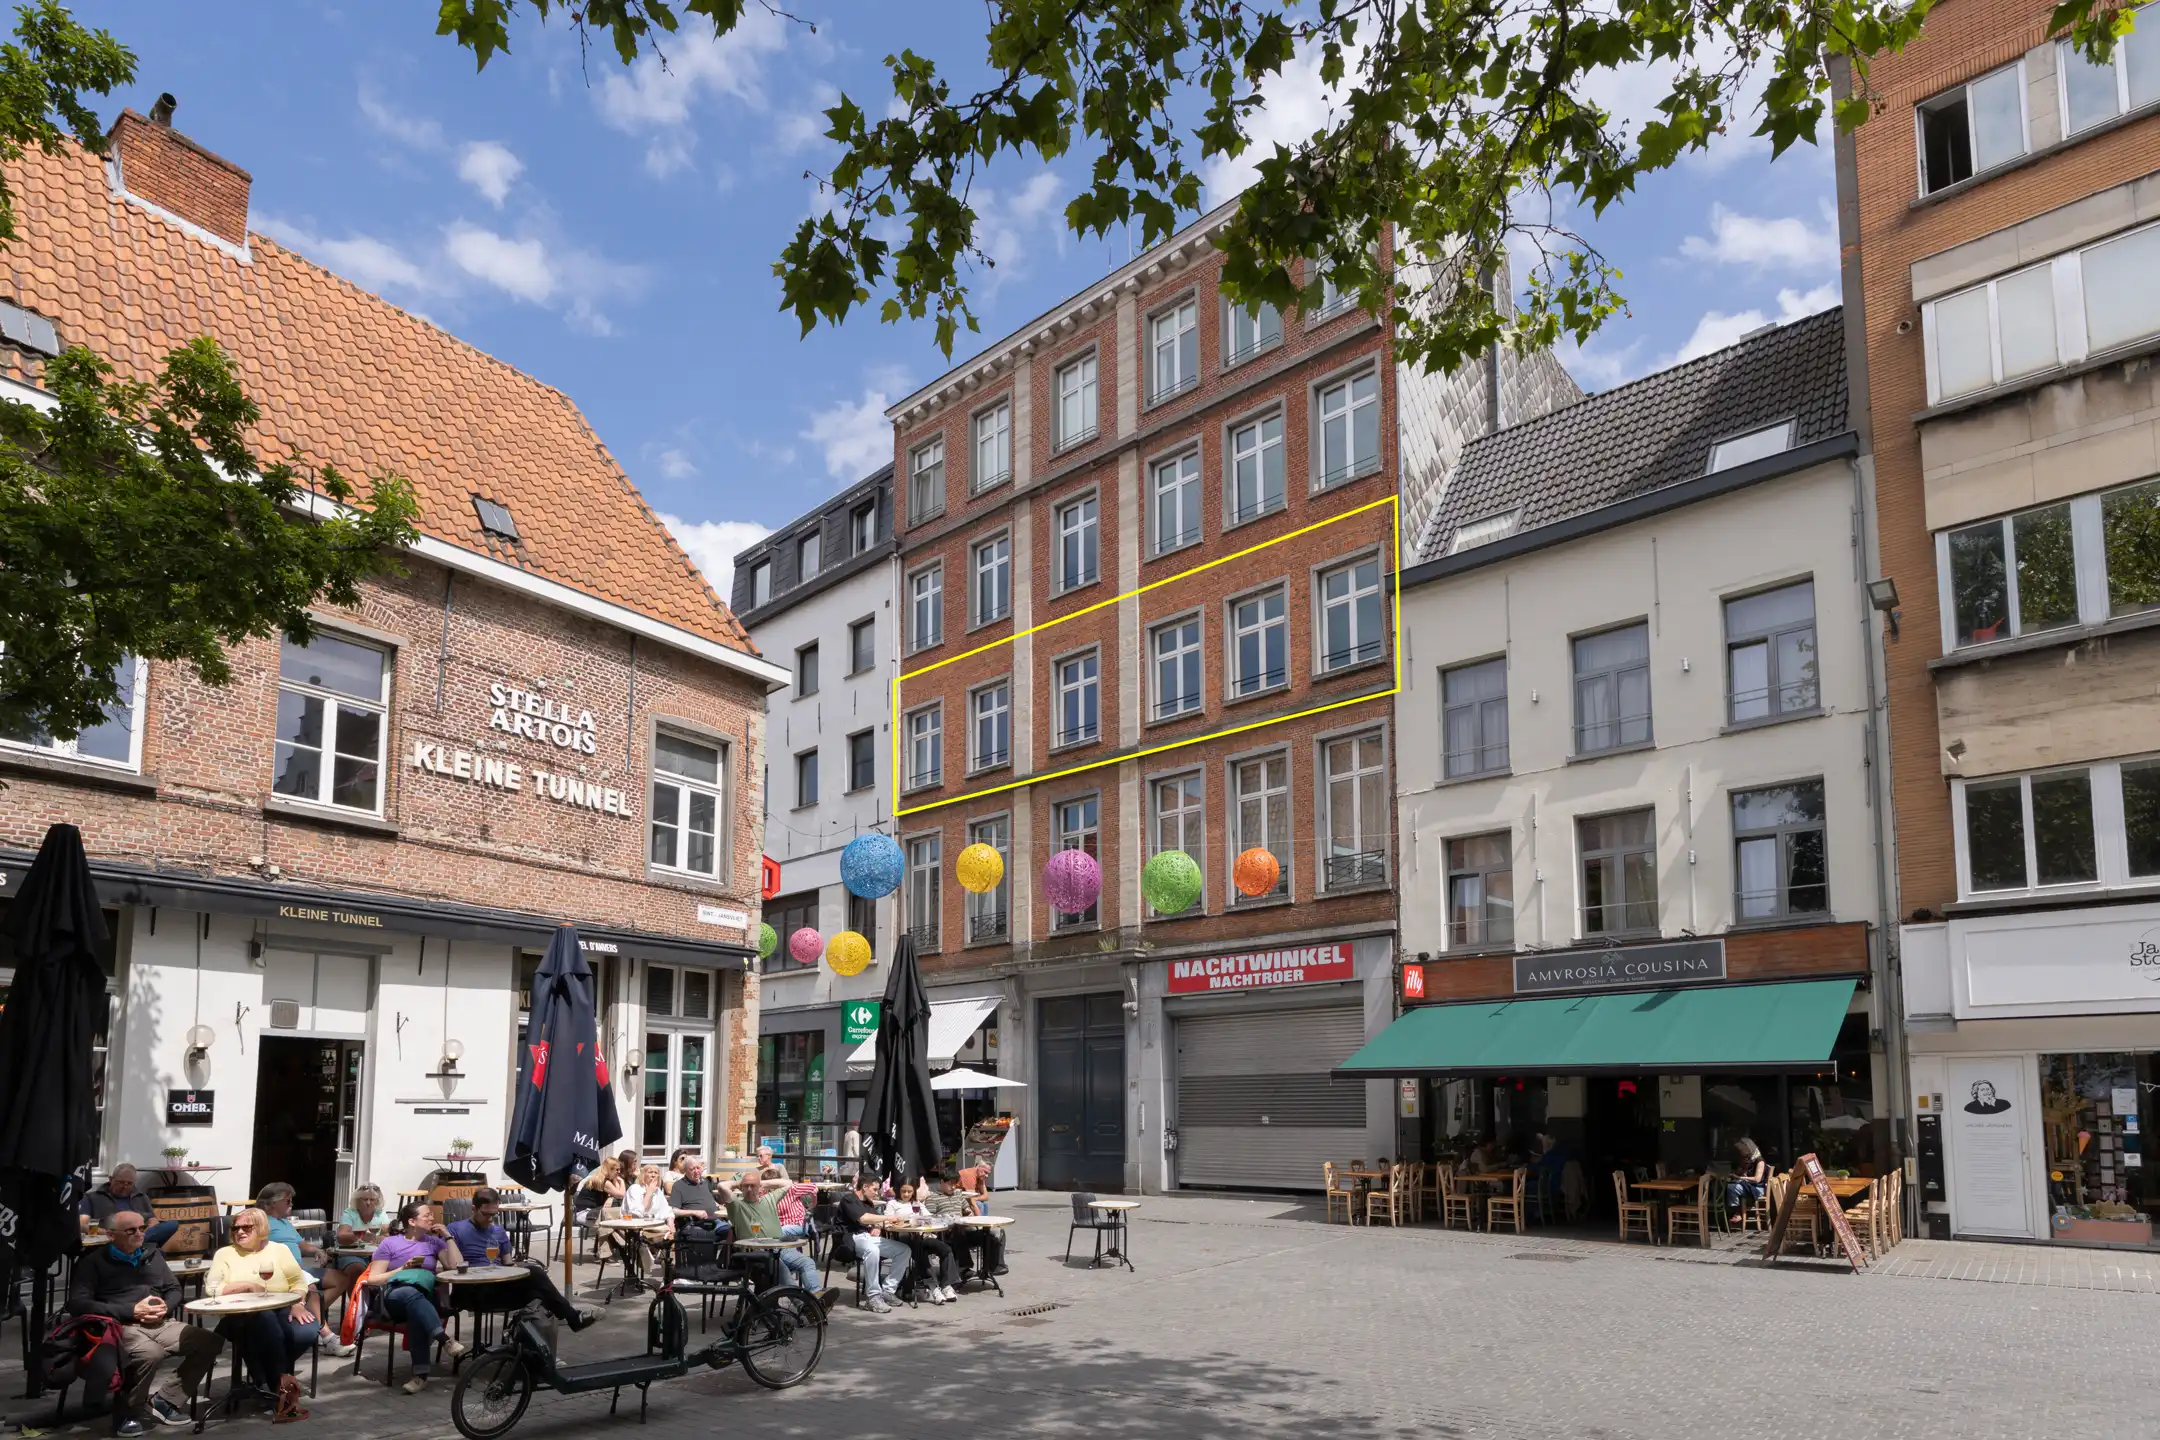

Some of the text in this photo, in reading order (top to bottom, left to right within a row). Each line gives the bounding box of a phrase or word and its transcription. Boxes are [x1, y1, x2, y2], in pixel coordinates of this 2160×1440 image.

[490, 683, 596, 732] STELLA
[489, 708, 596, 754] ARTOIS
[413, 741, 633, 818] KLEINE TUNNEL
[280, 906, 383, 927] KLEINE TUNNEL
[1174, 946, 1346, 978] NACHTWINKEL
[1527, 958, 1708, 983] AMVROSIA COUSINA
[1209, 969, 1304, 989] NACHTROER
[1406, 969, 1423, 994] illy
